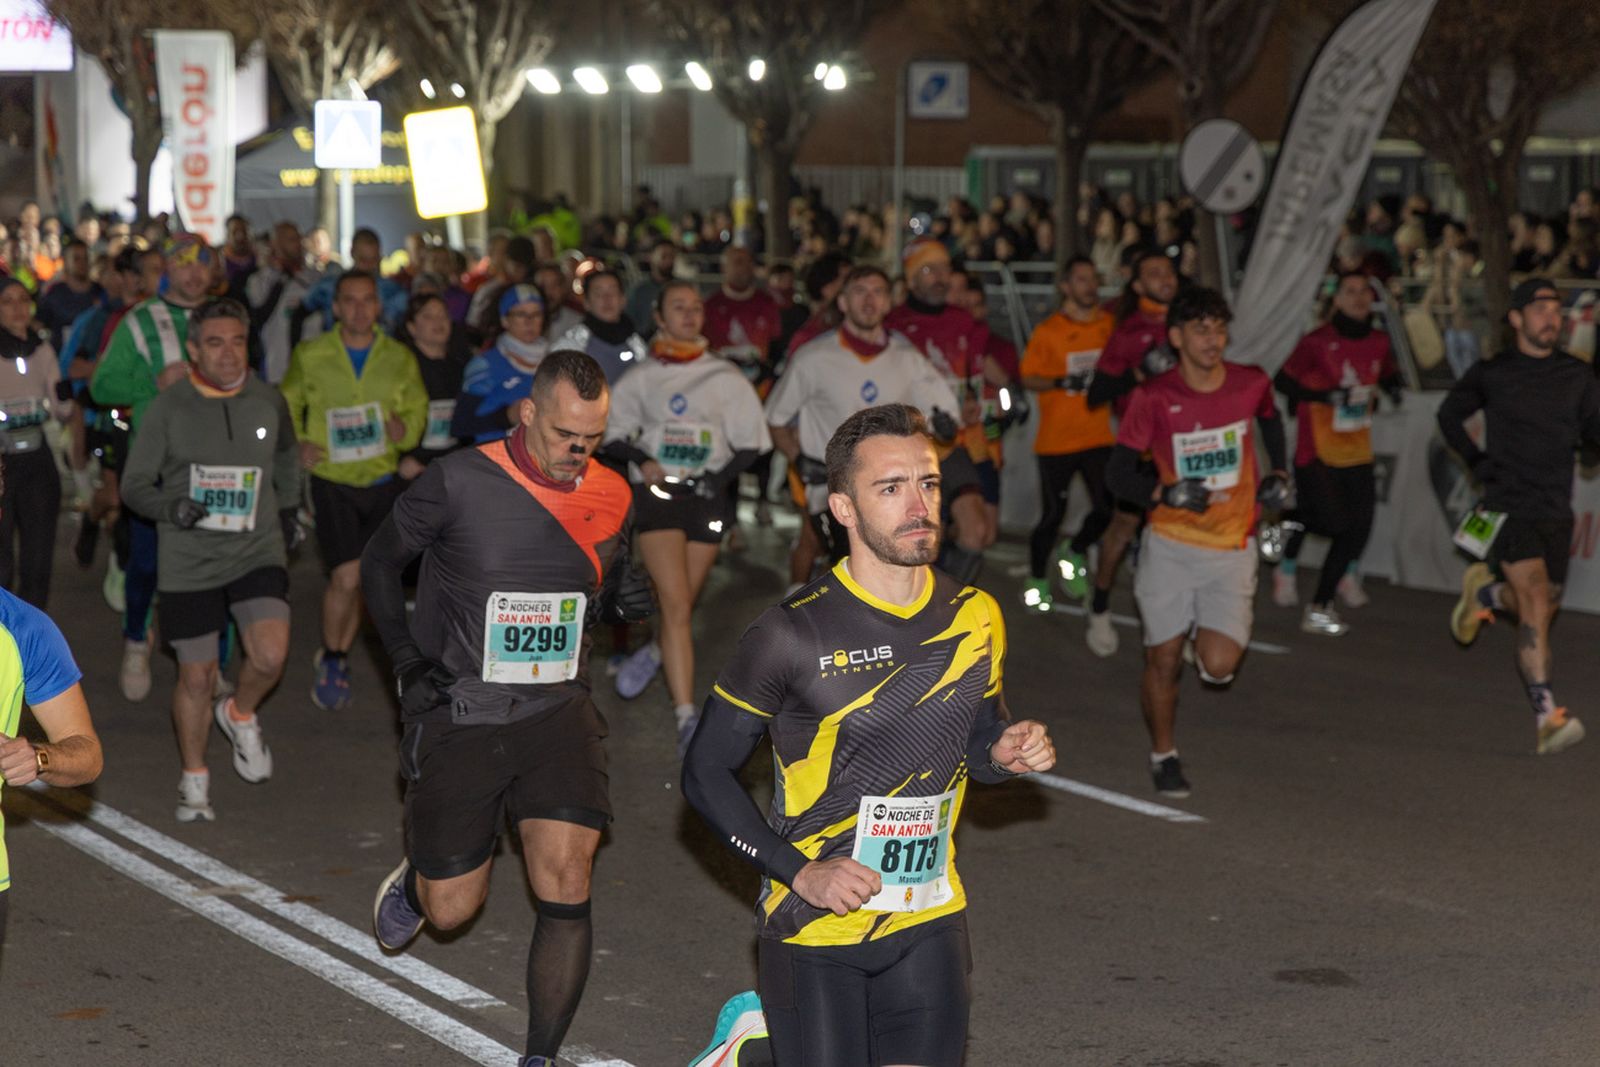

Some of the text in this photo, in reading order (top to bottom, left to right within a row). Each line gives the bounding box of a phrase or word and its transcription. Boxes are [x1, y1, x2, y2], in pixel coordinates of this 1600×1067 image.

[205, 489, 248, 510] 6910
[510, 603, 552, 612] NOCHE DE
[497, 613, 517, 624] SAN
[519, 611, 552, 624] ANTÓN
[504, 626, 567, 652] 9299
[819, 645, 893, 671] FOCUS
[821, 660, 895, 679] FITNESS
[887, 809, 935, 822] NOCHE DE
[871, 824, 896, 837] SAN
[897, 821, 933, 836] ANTÓN
[880, 836, 939, 873] 8173
